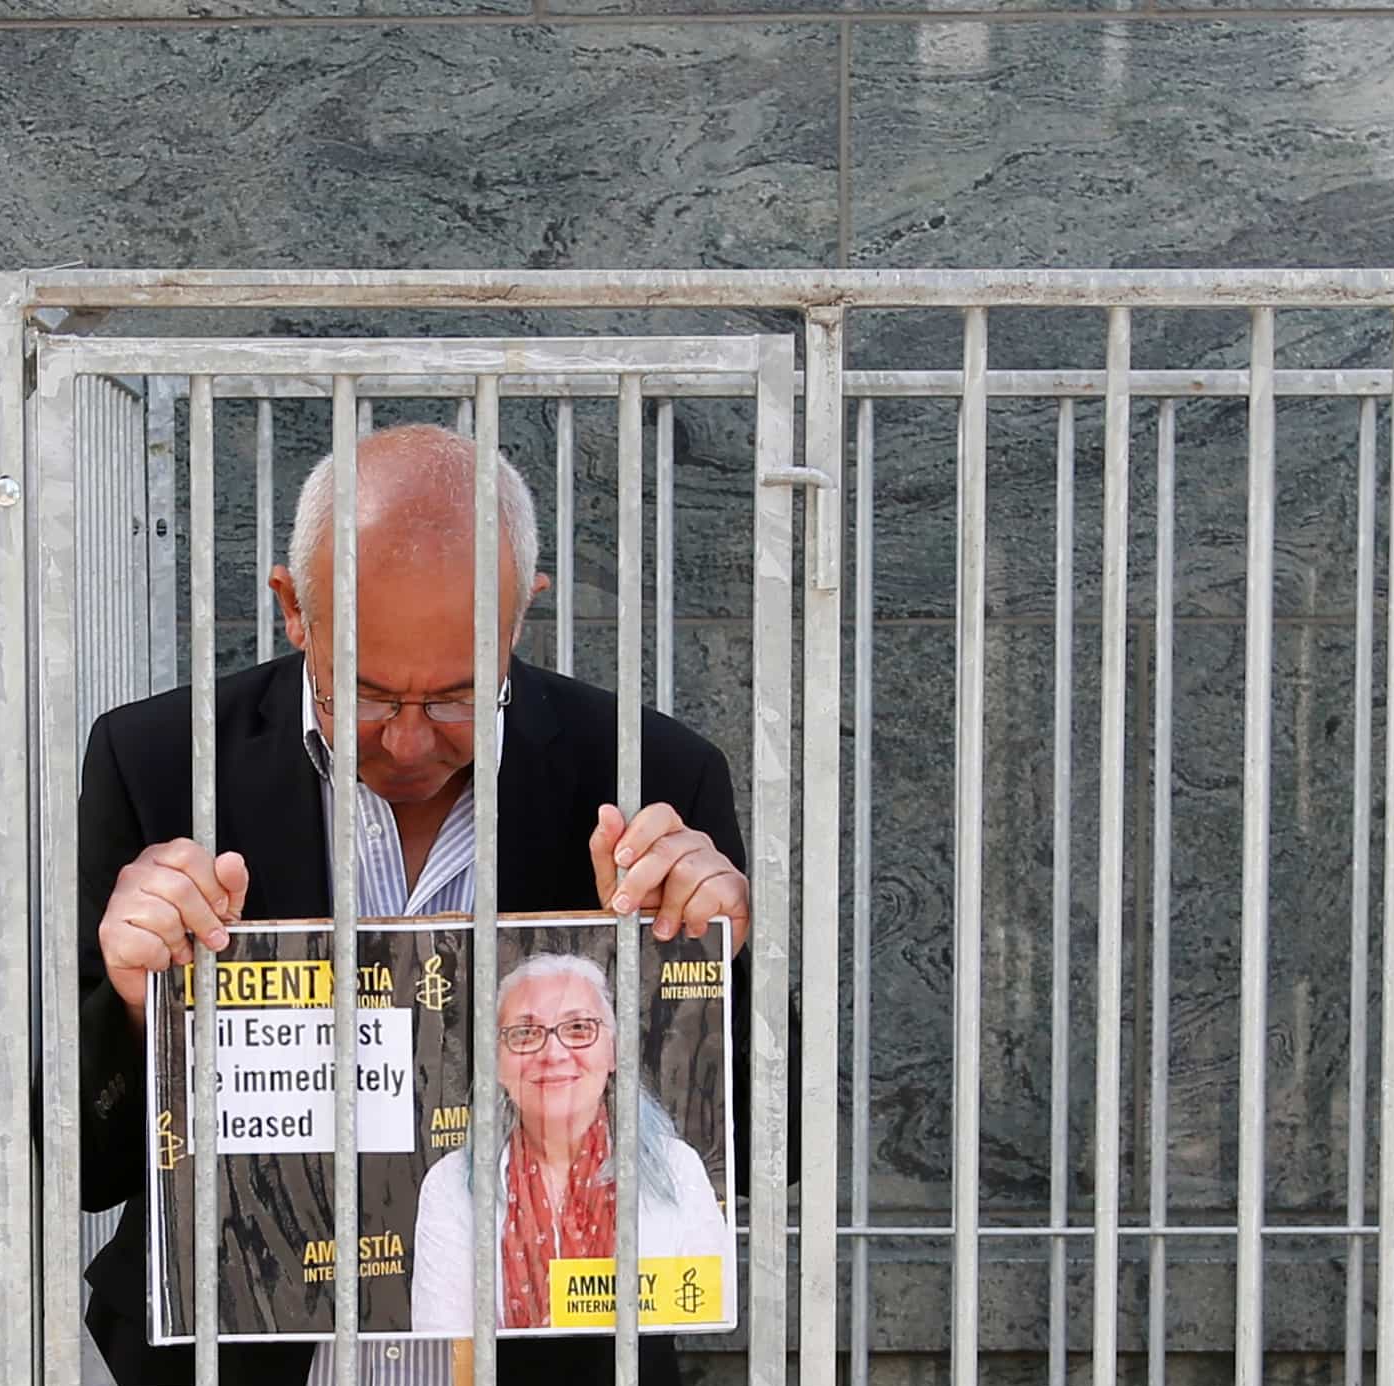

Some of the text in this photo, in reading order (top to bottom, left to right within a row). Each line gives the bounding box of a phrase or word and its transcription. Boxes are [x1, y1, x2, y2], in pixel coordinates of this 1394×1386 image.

[190, 965, 320, 1002] RGENT
[244, 1018, 306, 1047] Eser
[316, 1018, 383, 1046] mst
[234, 1063, 406, 1098] immeditely
[192, 1108, 313, 1139] leased
[303, 1230, 405, 1266] AMSTÍA
[304, 1259, 406, 1283] INTECIONAL
[567, 1273, 658, 1297] AMNTY
[567, 1298, 658, 1314] INTERNANAL
